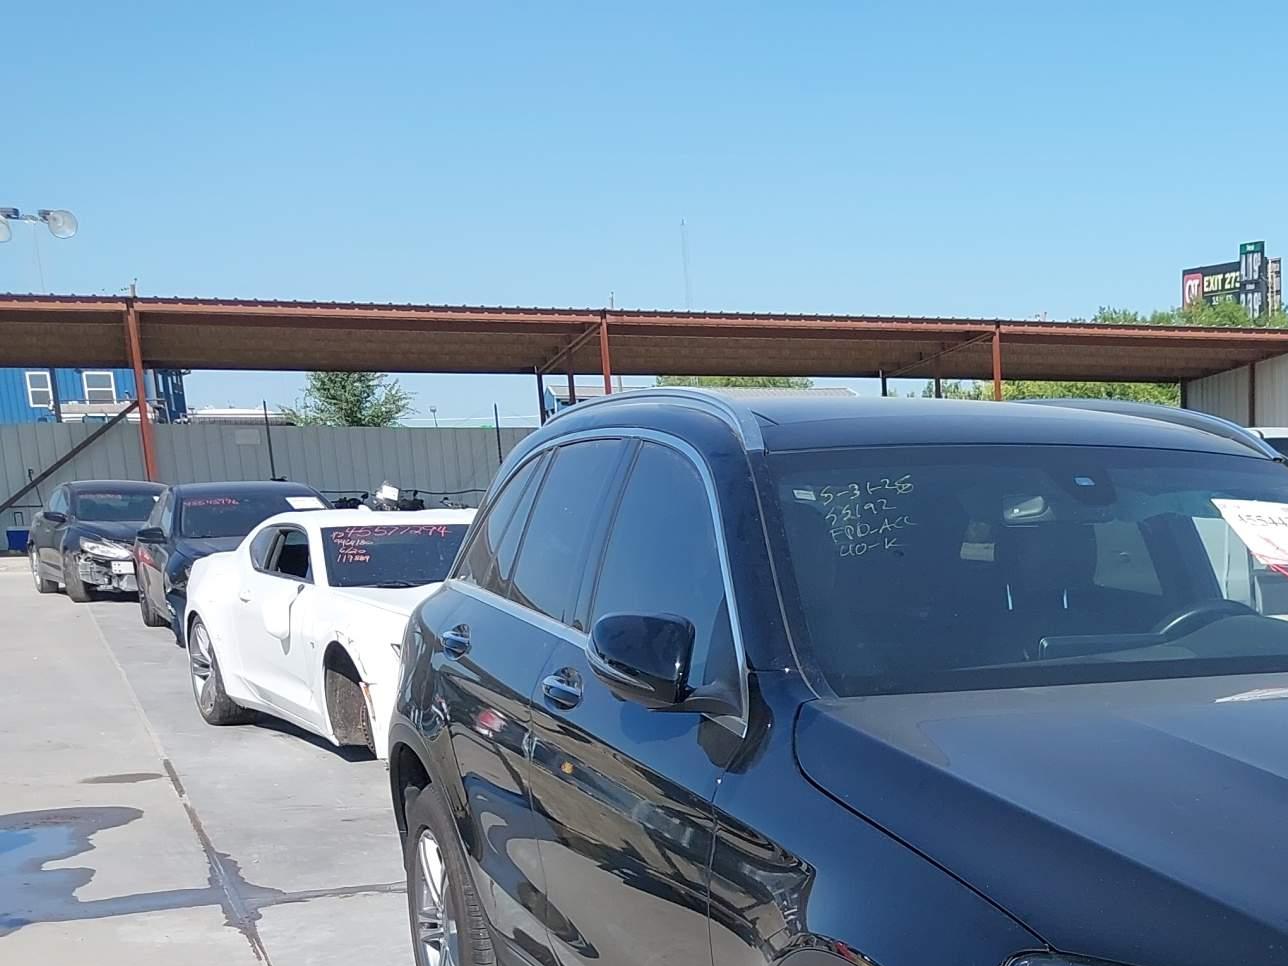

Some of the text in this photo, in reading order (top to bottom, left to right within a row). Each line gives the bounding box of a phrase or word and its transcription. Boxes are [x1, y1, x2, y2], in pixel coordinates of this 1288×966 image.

[1185, 279, 1200, 304] QT
[1203, 271, 1240, 292] EXIT 273
